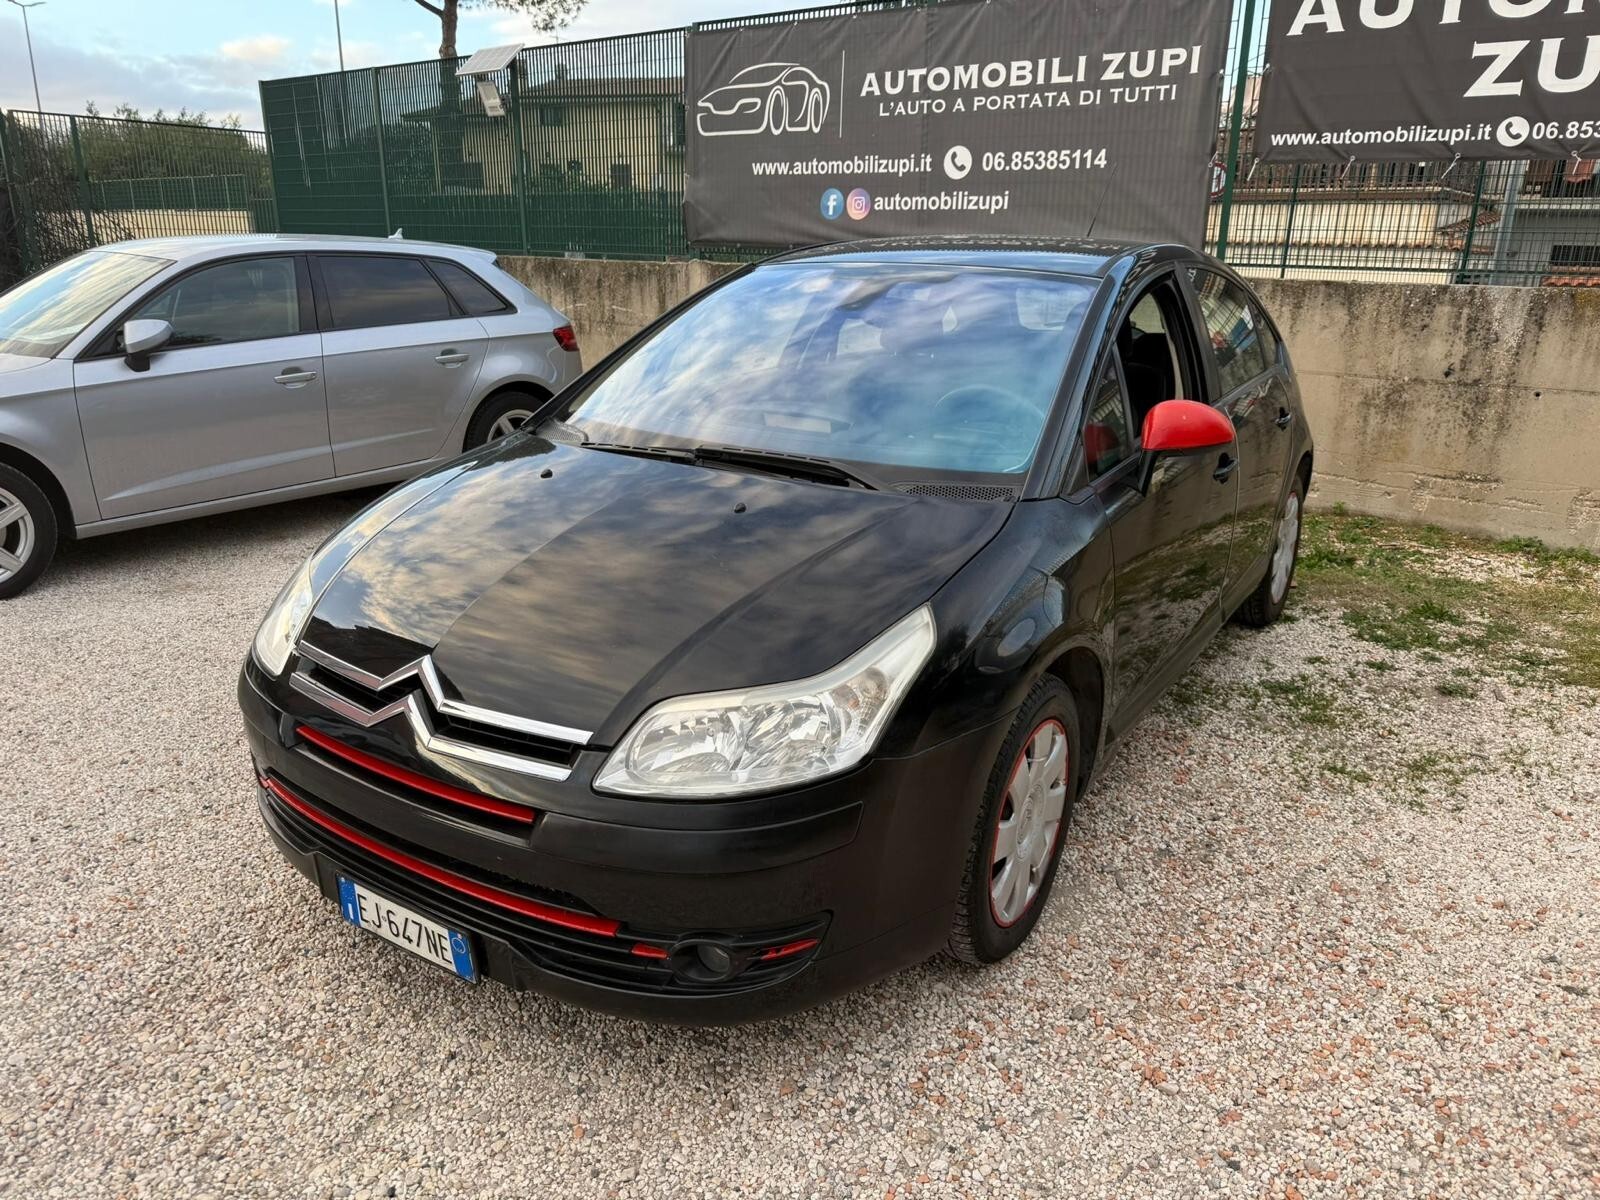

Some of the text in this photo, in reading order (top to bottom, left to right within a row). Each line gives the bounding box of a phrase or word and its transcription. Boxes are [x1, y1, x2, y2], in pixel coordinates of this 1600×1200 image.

[859, 44, 1202, 97] AUTOMOBILI ZUPI
[879, 84, 1177, 117] L'AUTO A PORTATA DI TUTTI
[1270, 123, 1492, 146] www.automobilizupi.it
[751, 148, 1108, 178] www.automobilizupi.it 06.85385114
[873, 190, 1010, 215] automobilizupi
[356, 893, 453, 965] EJ647NE
